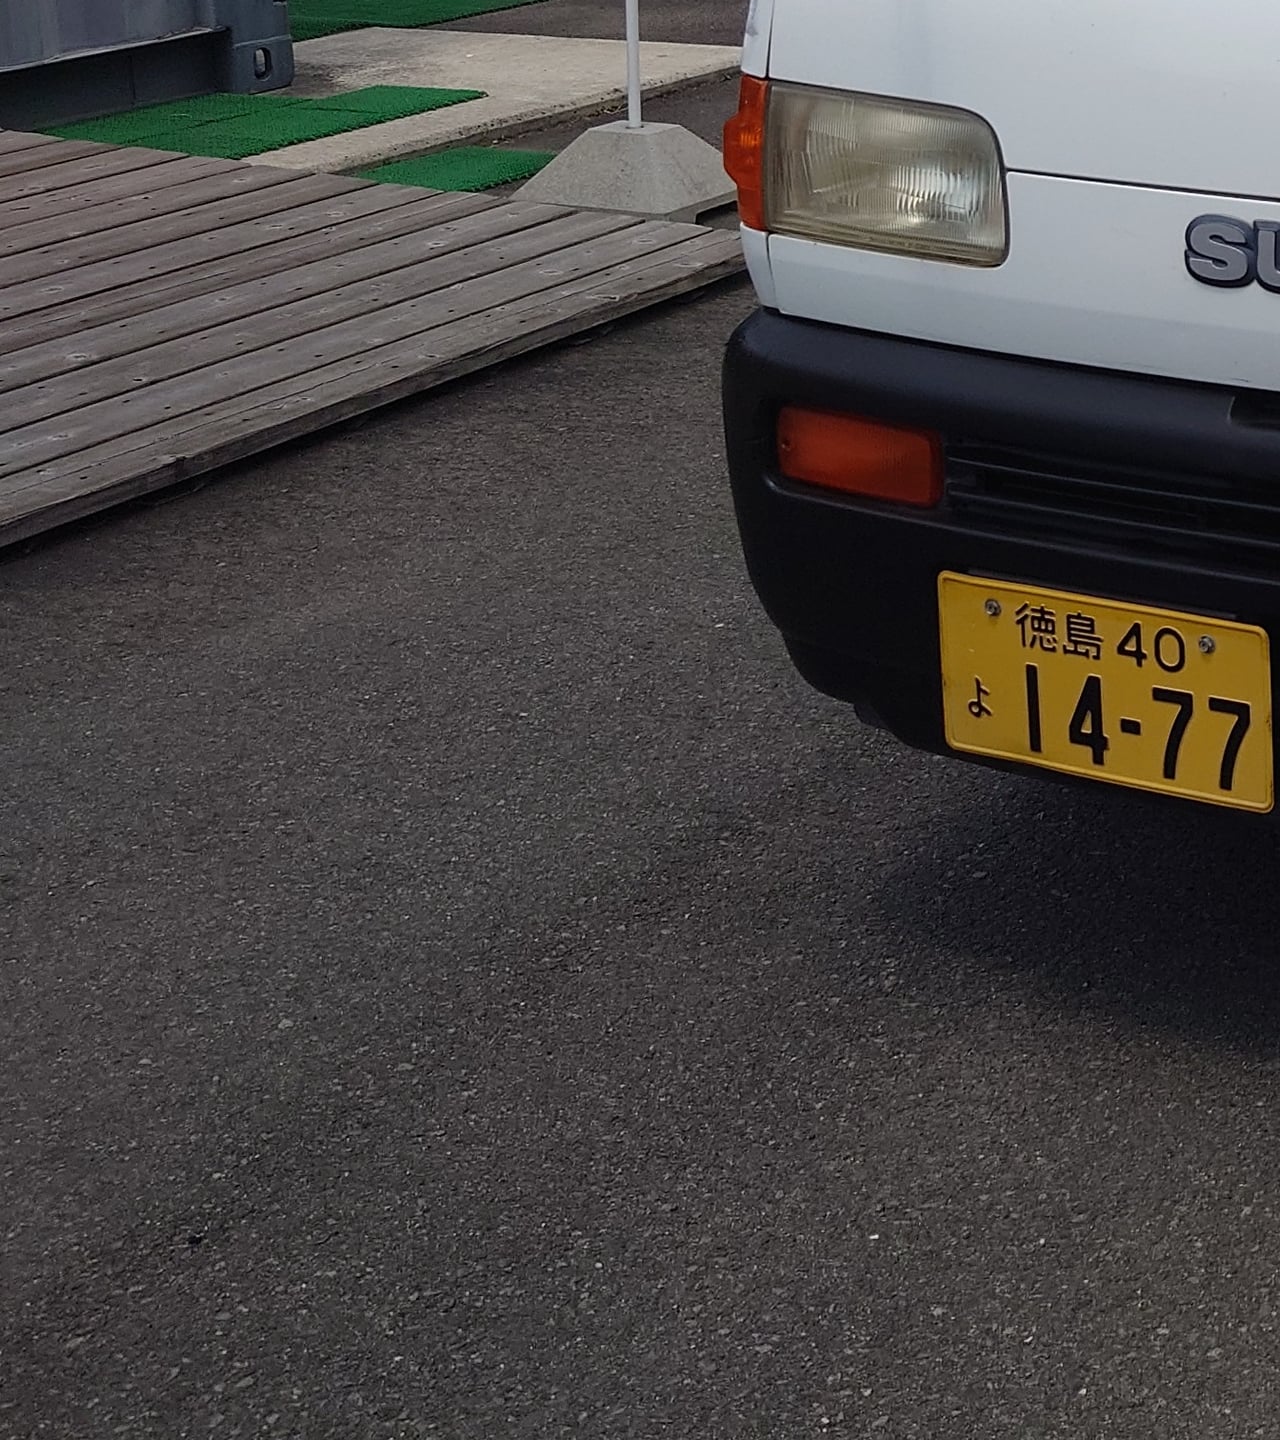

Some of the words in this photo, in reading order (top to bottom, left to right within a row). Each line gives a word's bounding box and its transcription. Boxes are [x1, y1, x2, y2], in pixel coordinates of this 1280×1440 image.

[1014, 601, 1104, 661] 徳島
[1116, 620, 1186, 673] 40
[967, 675, 994, 719] よ
[1025, 662, 1252, 792] 14-77
